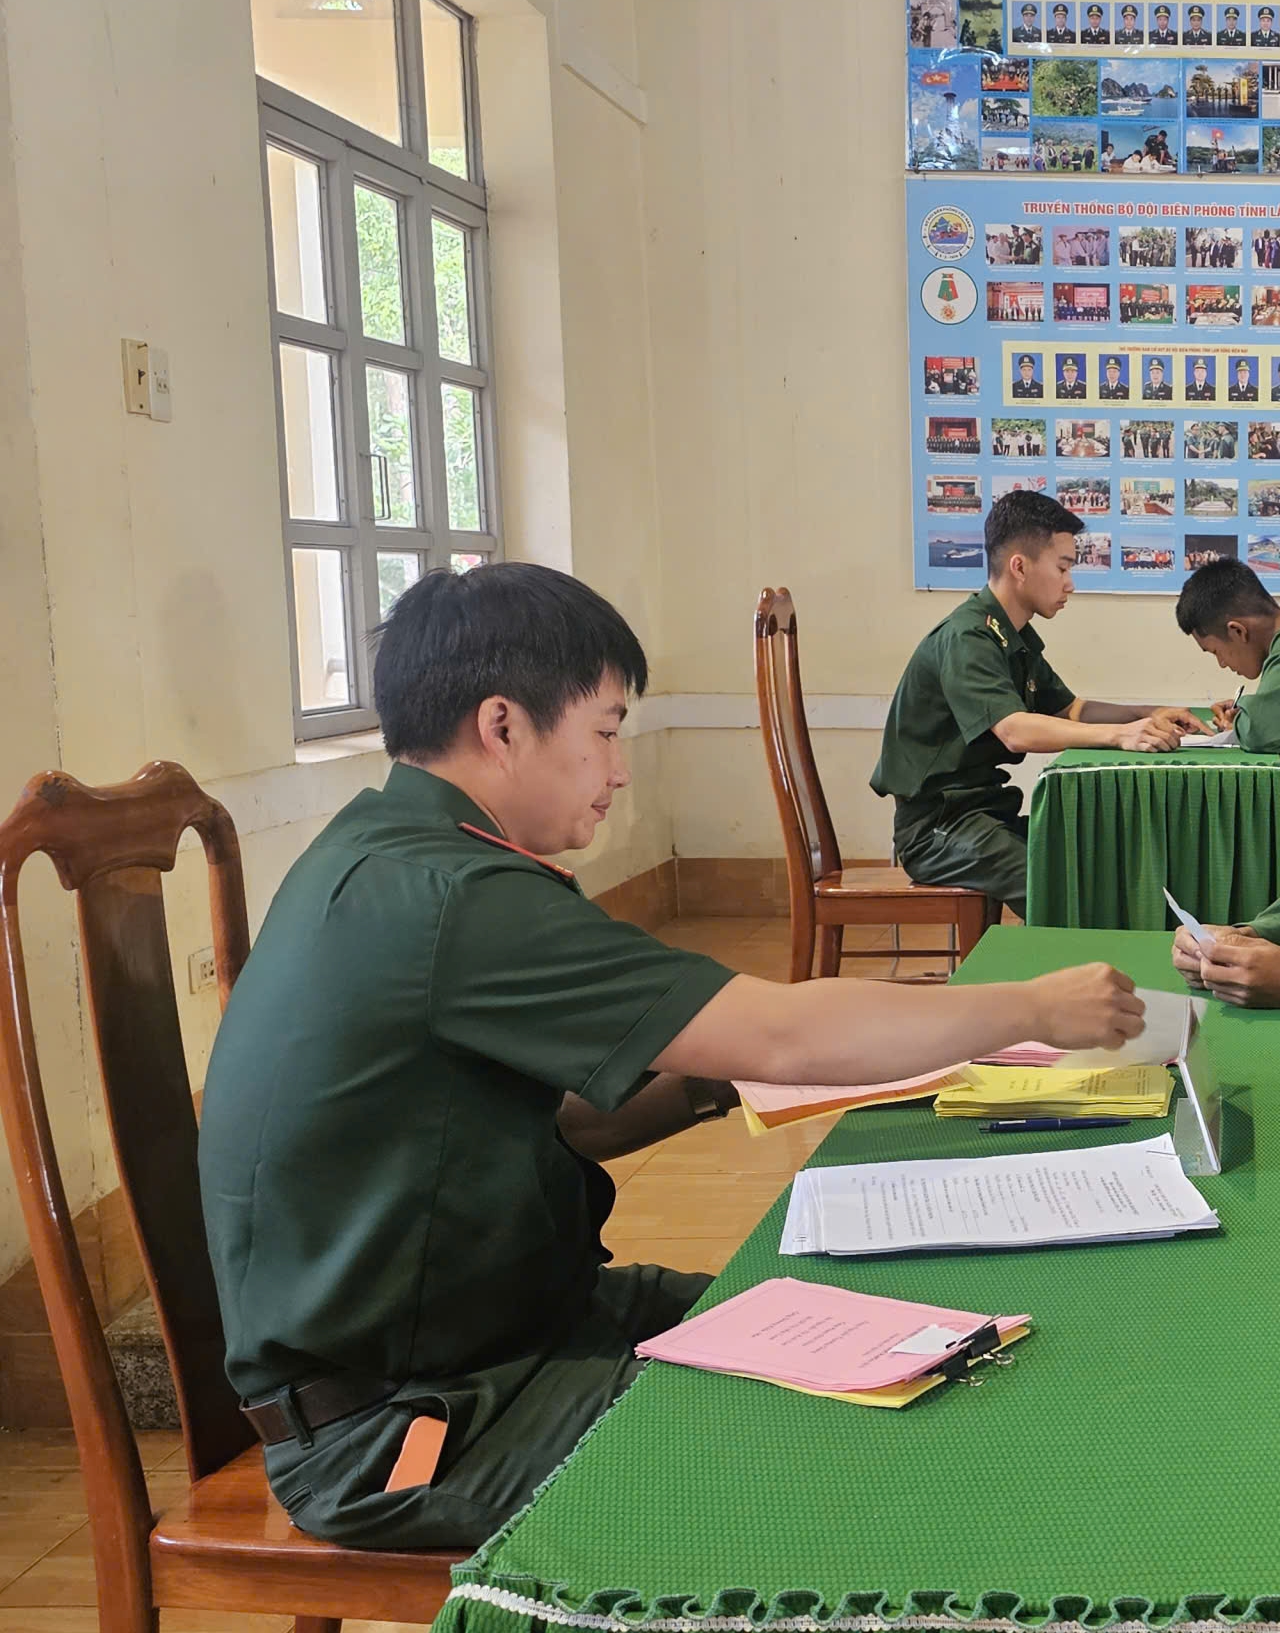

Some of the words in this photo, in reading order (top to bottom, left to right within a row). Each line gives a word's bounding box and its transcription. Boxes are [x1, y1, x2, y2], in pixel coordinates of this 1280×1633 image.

[1118, 203, 1133, 217] BỘ
[1137, 203, 1158, 217] ĐỘI
[1162, 203, 1190, 216] BIÊN
